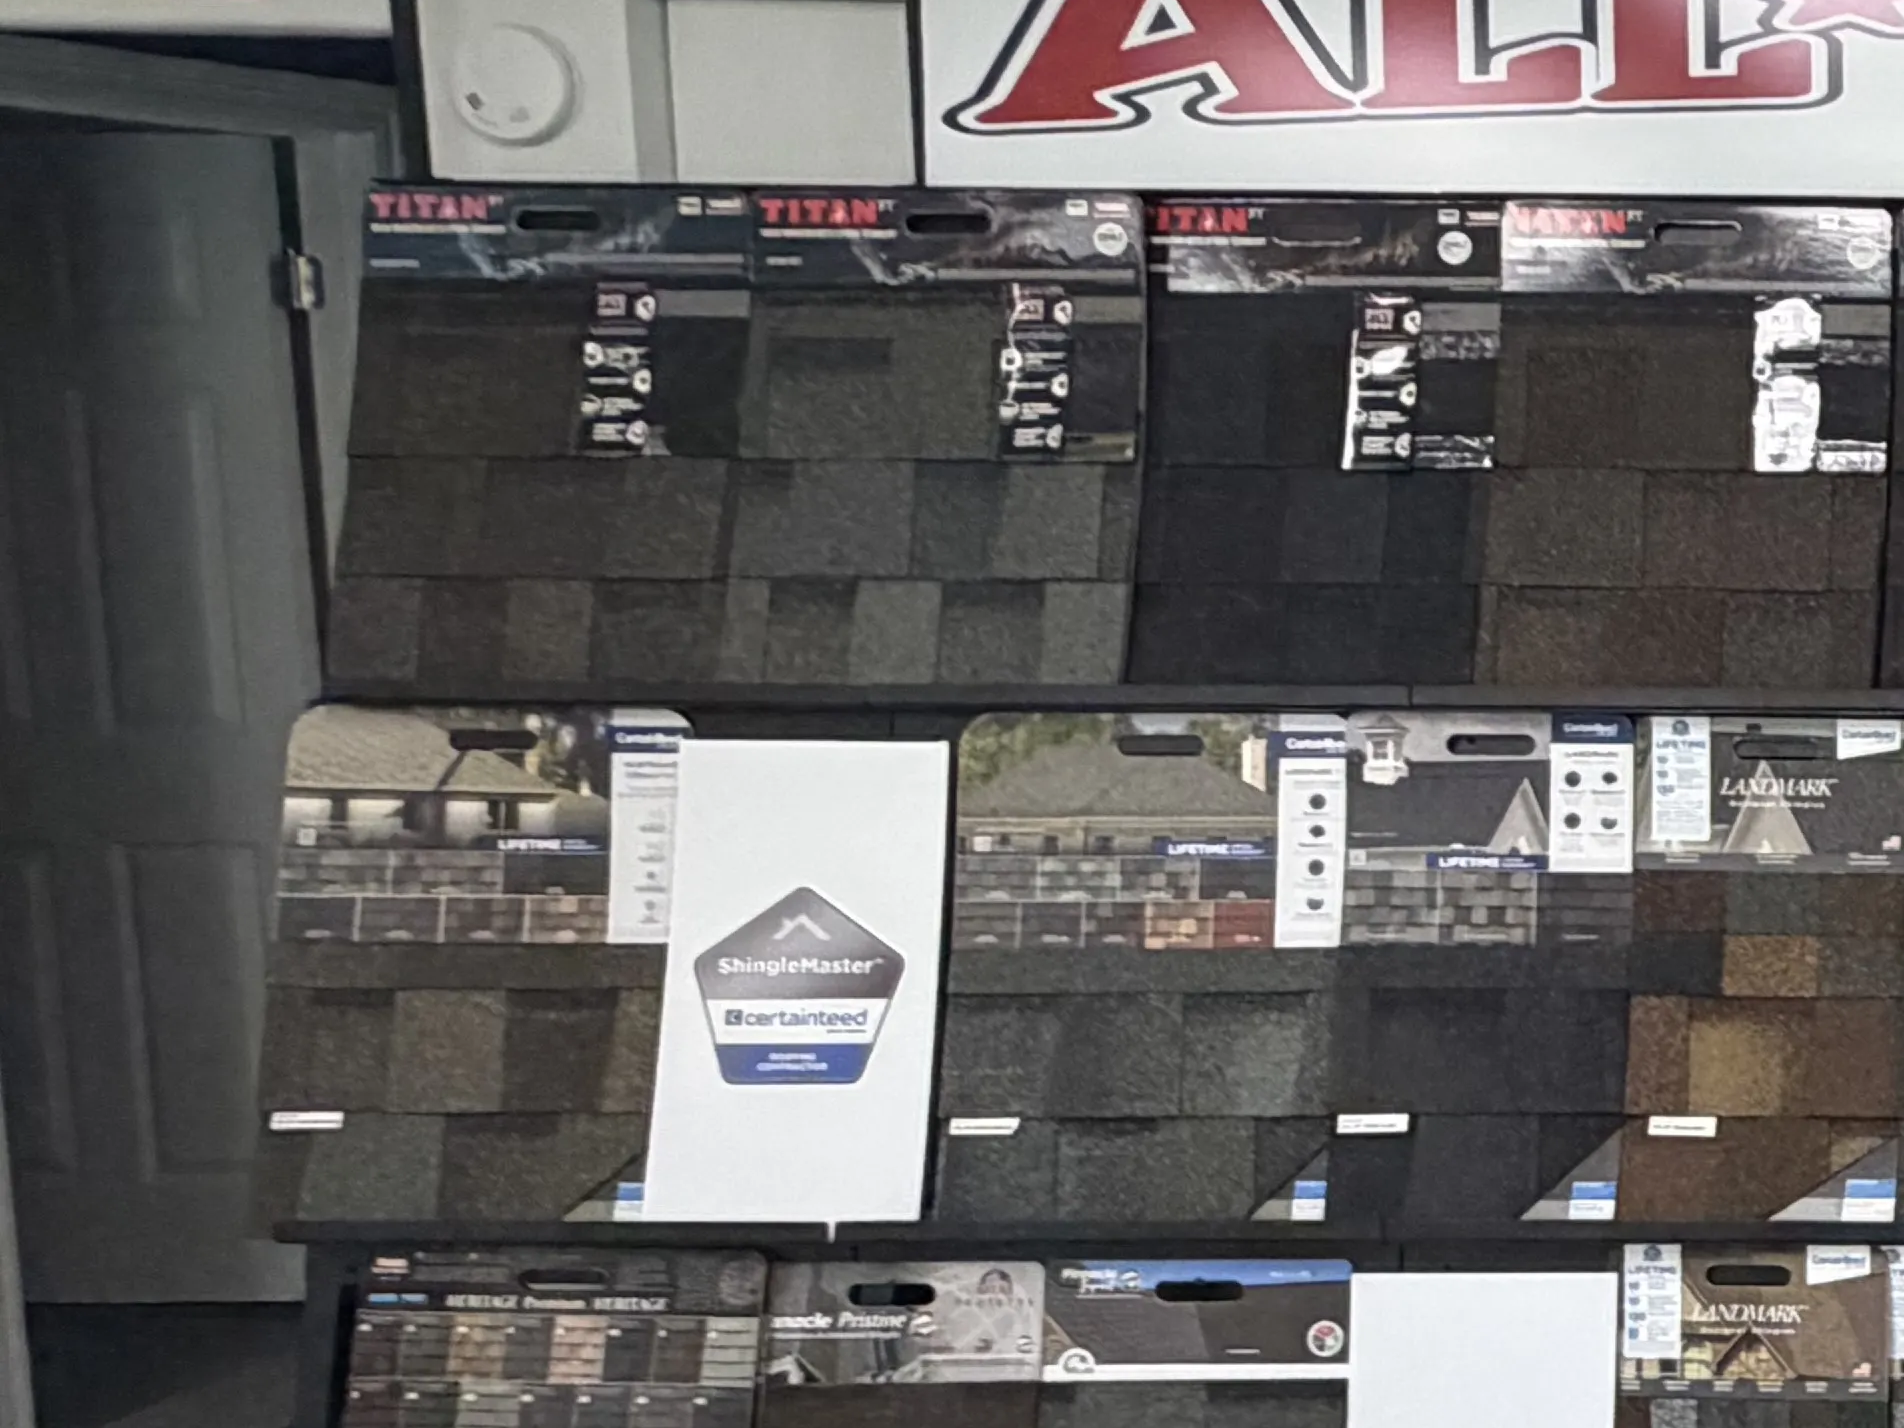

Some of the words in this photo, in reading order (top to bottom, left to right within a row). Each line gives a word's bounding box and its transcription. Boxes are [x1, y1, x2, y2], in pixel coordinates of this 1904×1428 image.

[370, 194, 490, 220] TITAN
[759, 198, 879, 225] TITAN
[1147, 206, 1249, 233] ITAN
[1720, 776, 1833, 797] LANDMARK
[717, 956, 874, 977] ShingleMaster
[745, 1009, 868, 1026] certainteed
[1691, 1304, 1802, 1323] LANDMARK
